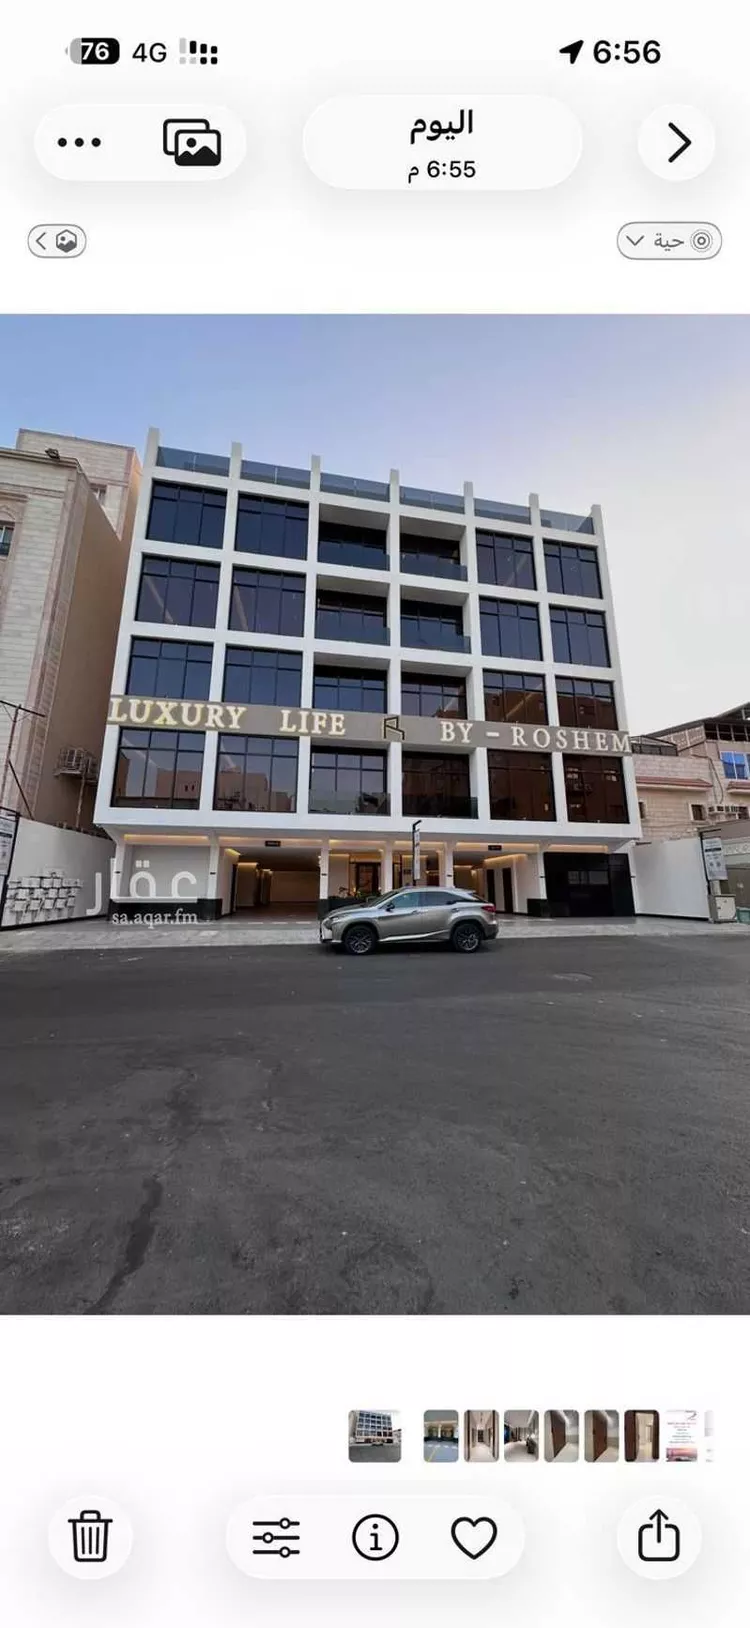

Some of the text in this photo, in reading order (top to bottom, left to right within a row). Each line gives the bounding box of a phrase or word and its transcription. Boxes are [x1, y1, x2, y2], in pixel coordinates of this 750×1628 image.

[81, 42, 109, 60] 76
[132, 43, 167, 62] 4G
[593, 40, 661, 64] 6:56
[410, 109, 473, 143] اليوم
[407, 161, 476, 184] 6:55 م
[654, 232, 685, 251] حية
[108, 697, 246, 728] LUXURY
[280, 709, 346, 735] LIFE
[440, 721, 473, 743] BY
[511, 726, 631, 753] ROSHEM
